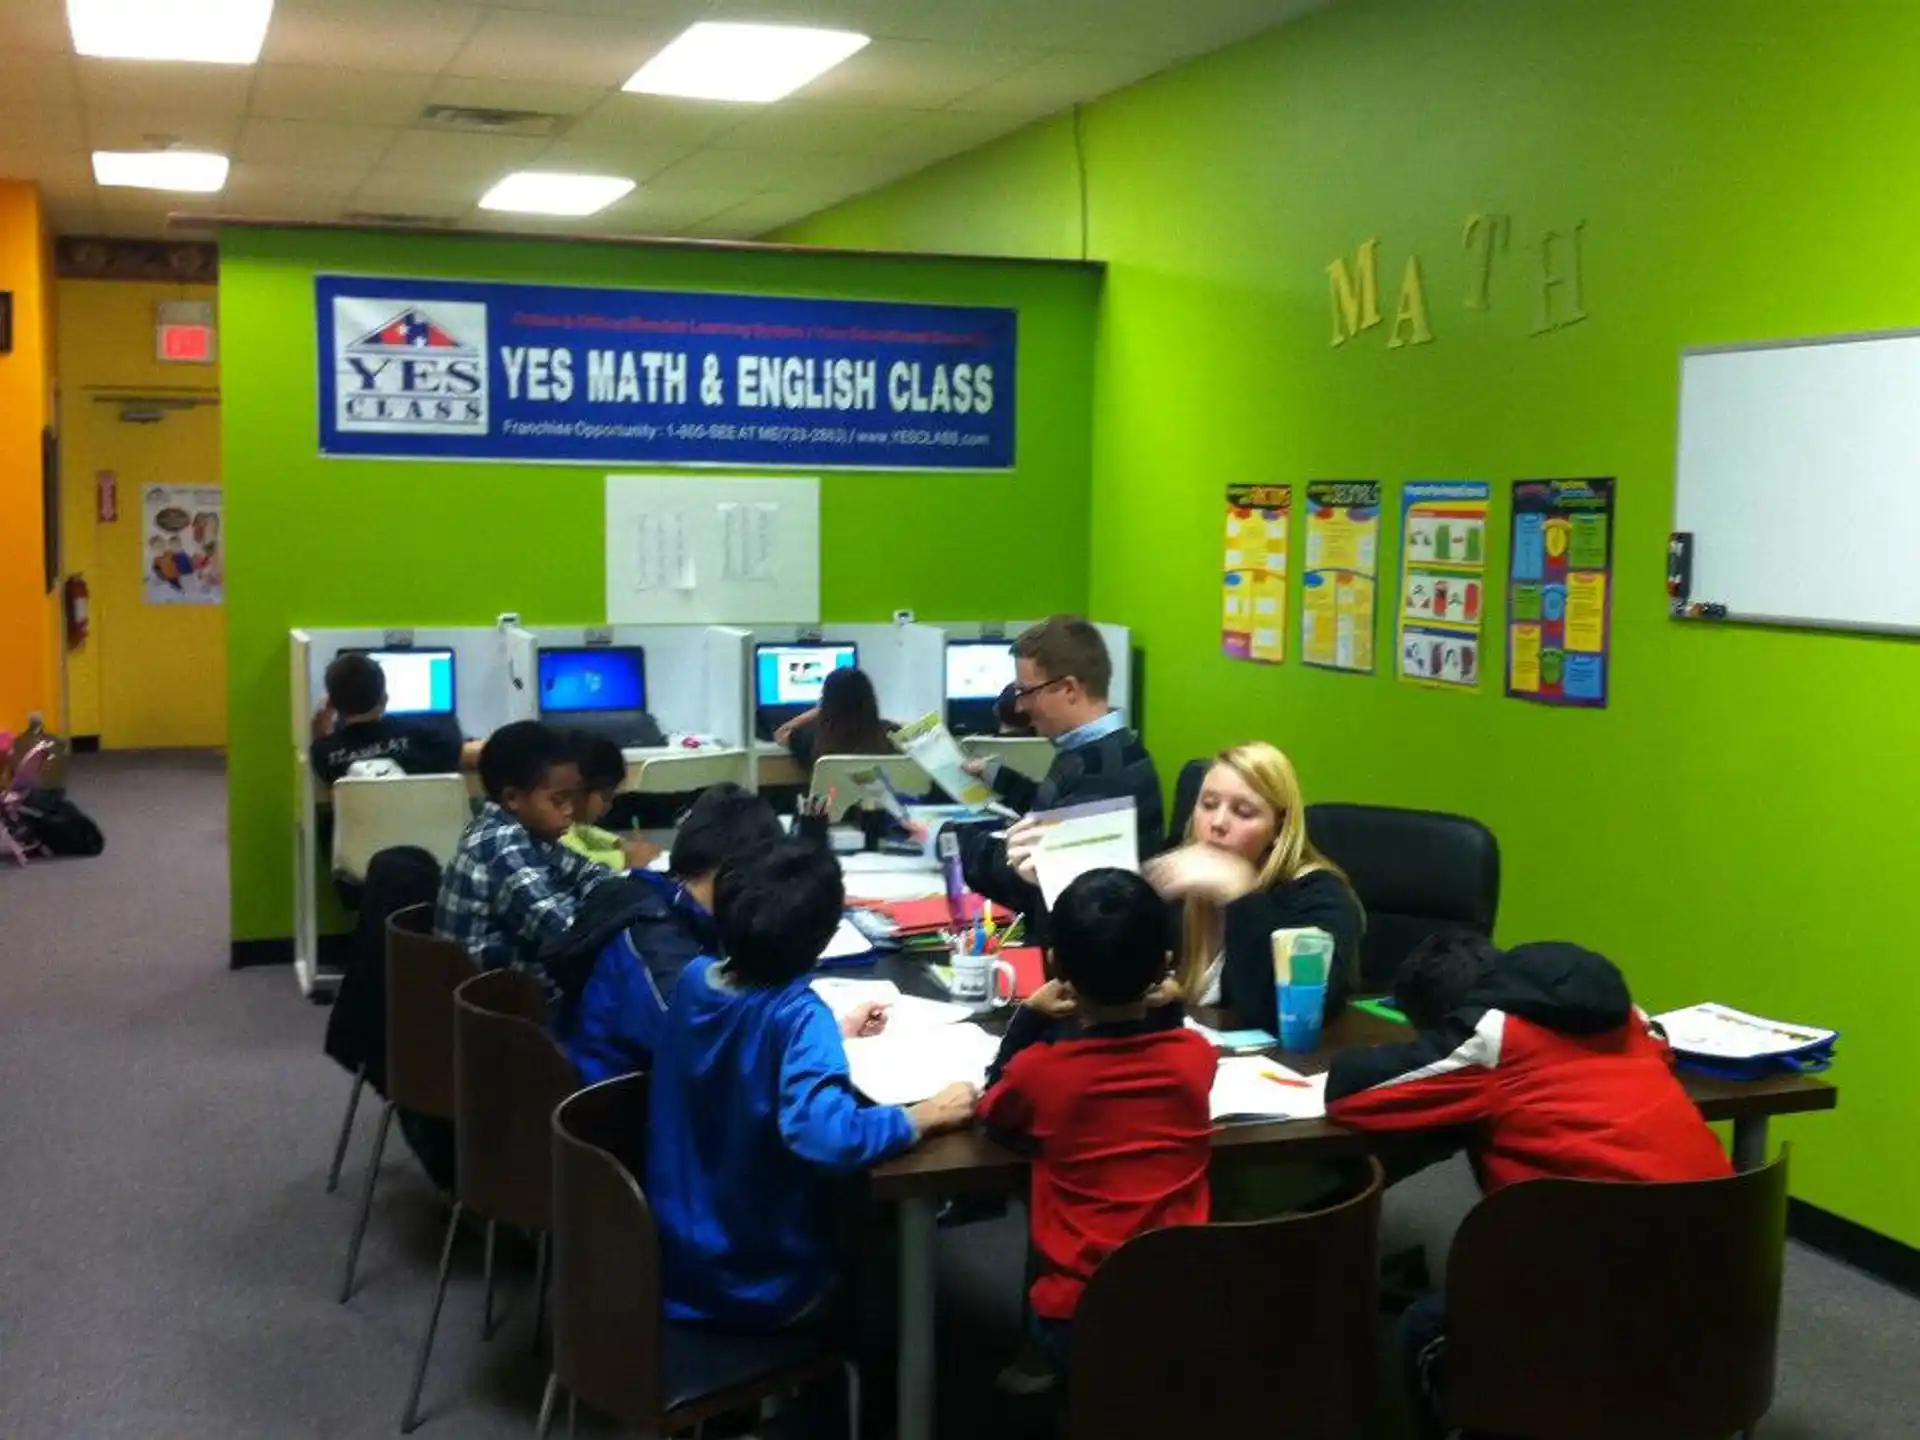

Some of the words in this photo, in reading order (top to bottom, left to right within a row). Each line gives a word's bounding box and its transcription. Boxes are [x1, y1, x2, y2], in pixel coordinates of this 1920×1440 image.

[1325, 212, 1588, 349] MATH
[345, 357, 481, 394] YES
[501, 345, 573, 402] YES
[588, 350, 688, 404] MATH
[701, 353, 724, 406] &
[737, 355, 876, 411] ENGLISH
[888, 360, 994, 414] CLASS
[345, 399, 481, 421] CLASS
[503, 418, 572, 437] Franchise
[574, 419, 656, 441] Opportunity
